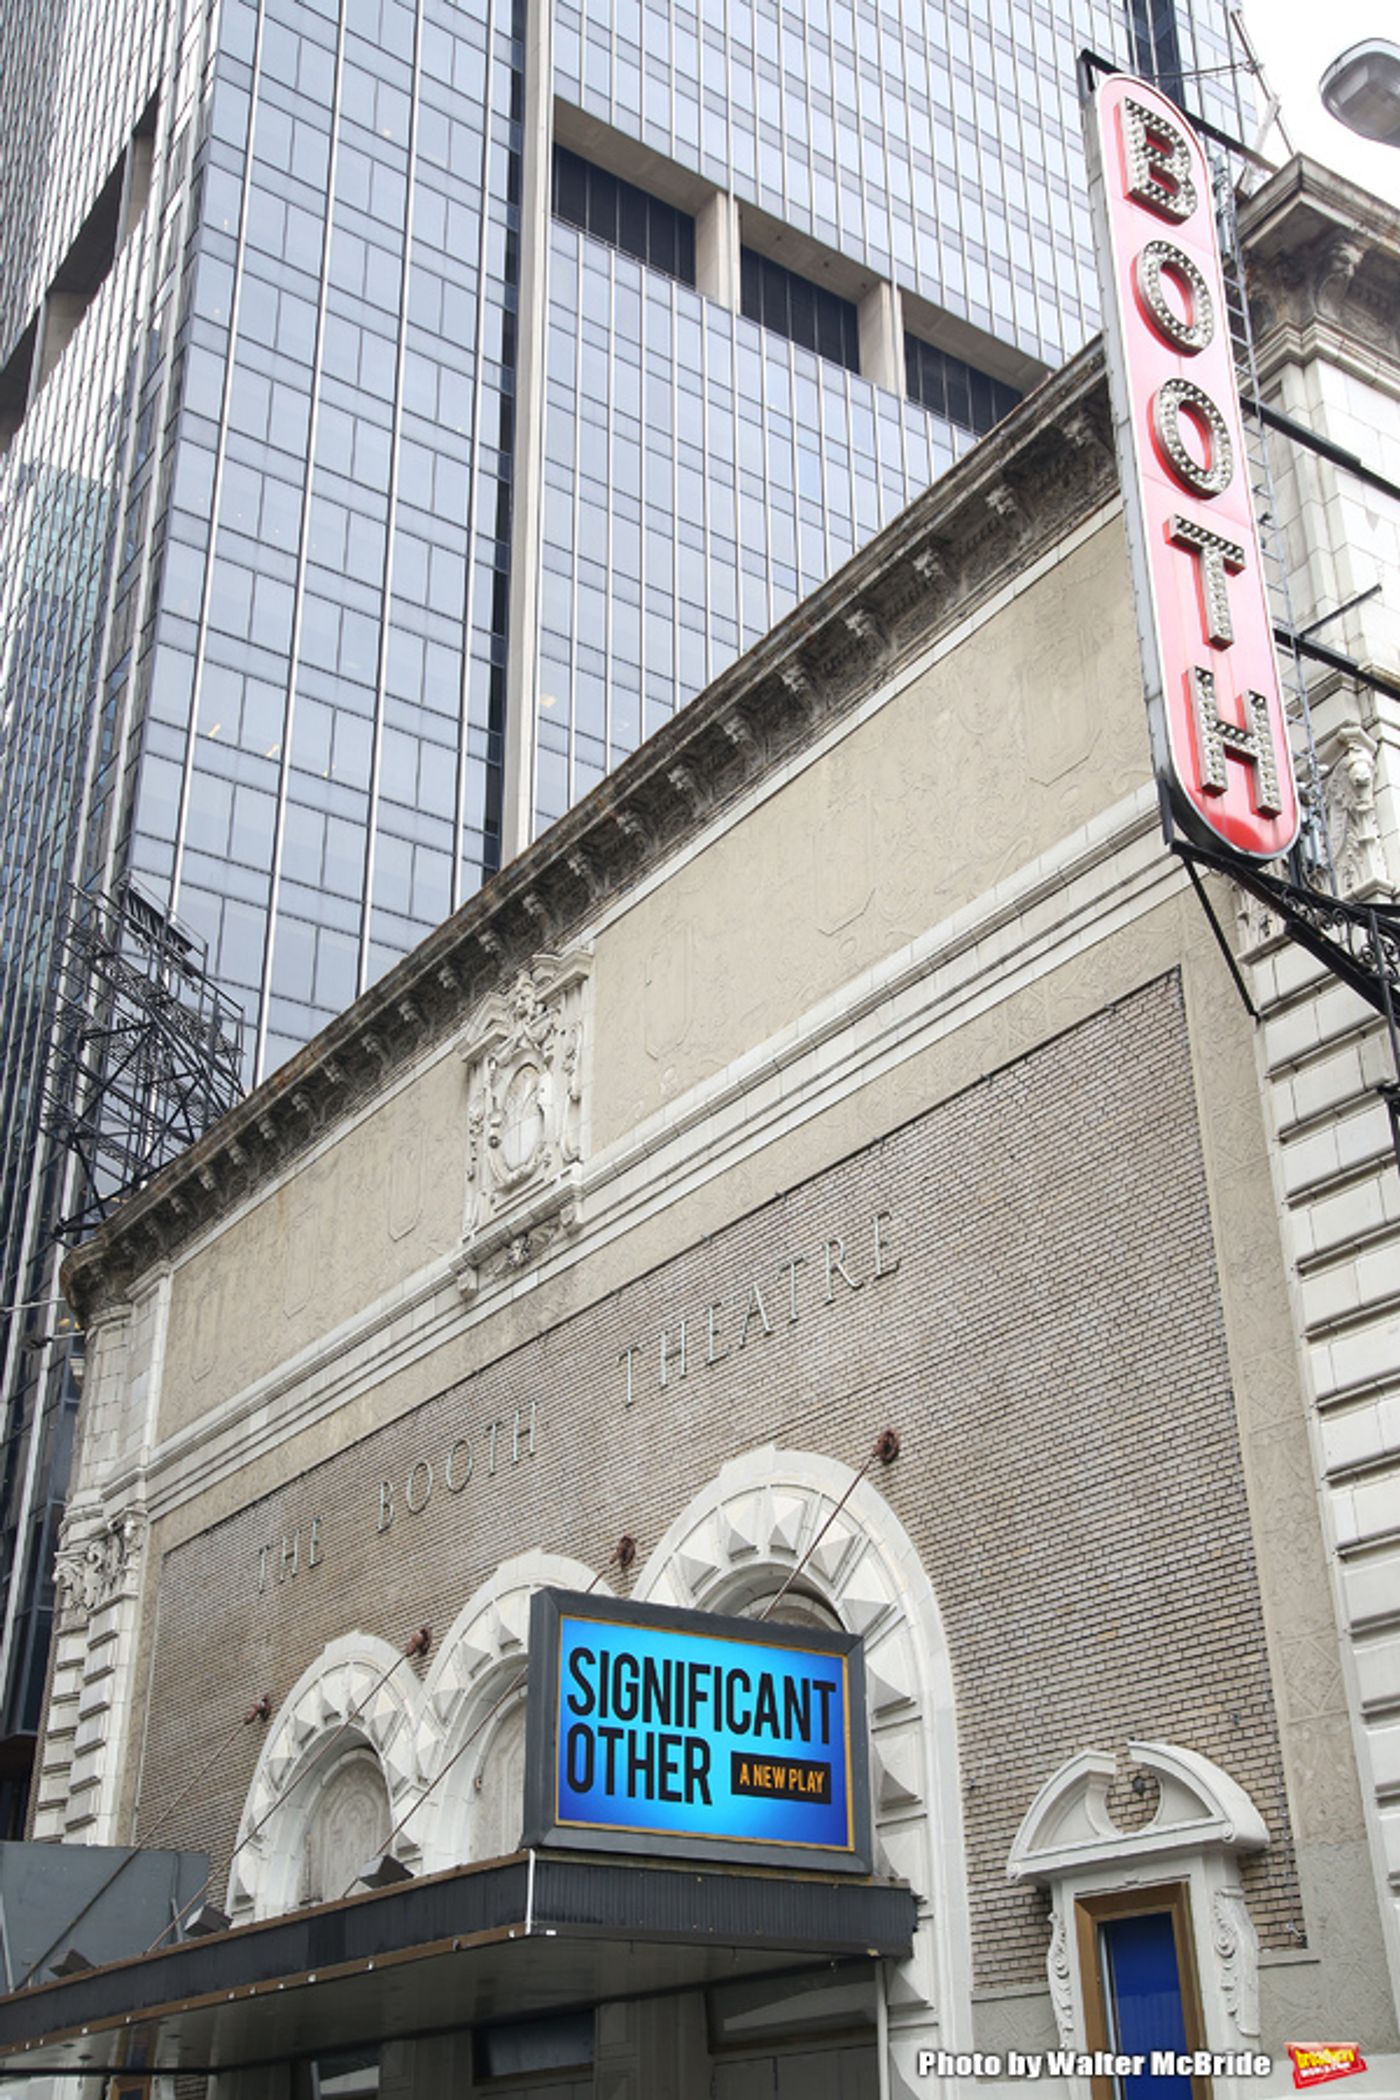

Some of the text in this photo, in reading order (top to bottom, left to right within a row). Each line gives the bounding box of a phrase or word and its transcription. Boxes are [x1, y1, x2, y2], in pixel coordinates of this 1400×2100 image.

[1119, 97, 1282, 818] BOOTH
[257, 1210, 900, 1594] THE BOOTH THEATRE
[567, 1647, 836, 1745] SIGNIFICANT
[567, 1722, 713, 1806] OTHER
[739, 1763, 825, 1793] A NEW PLAY
